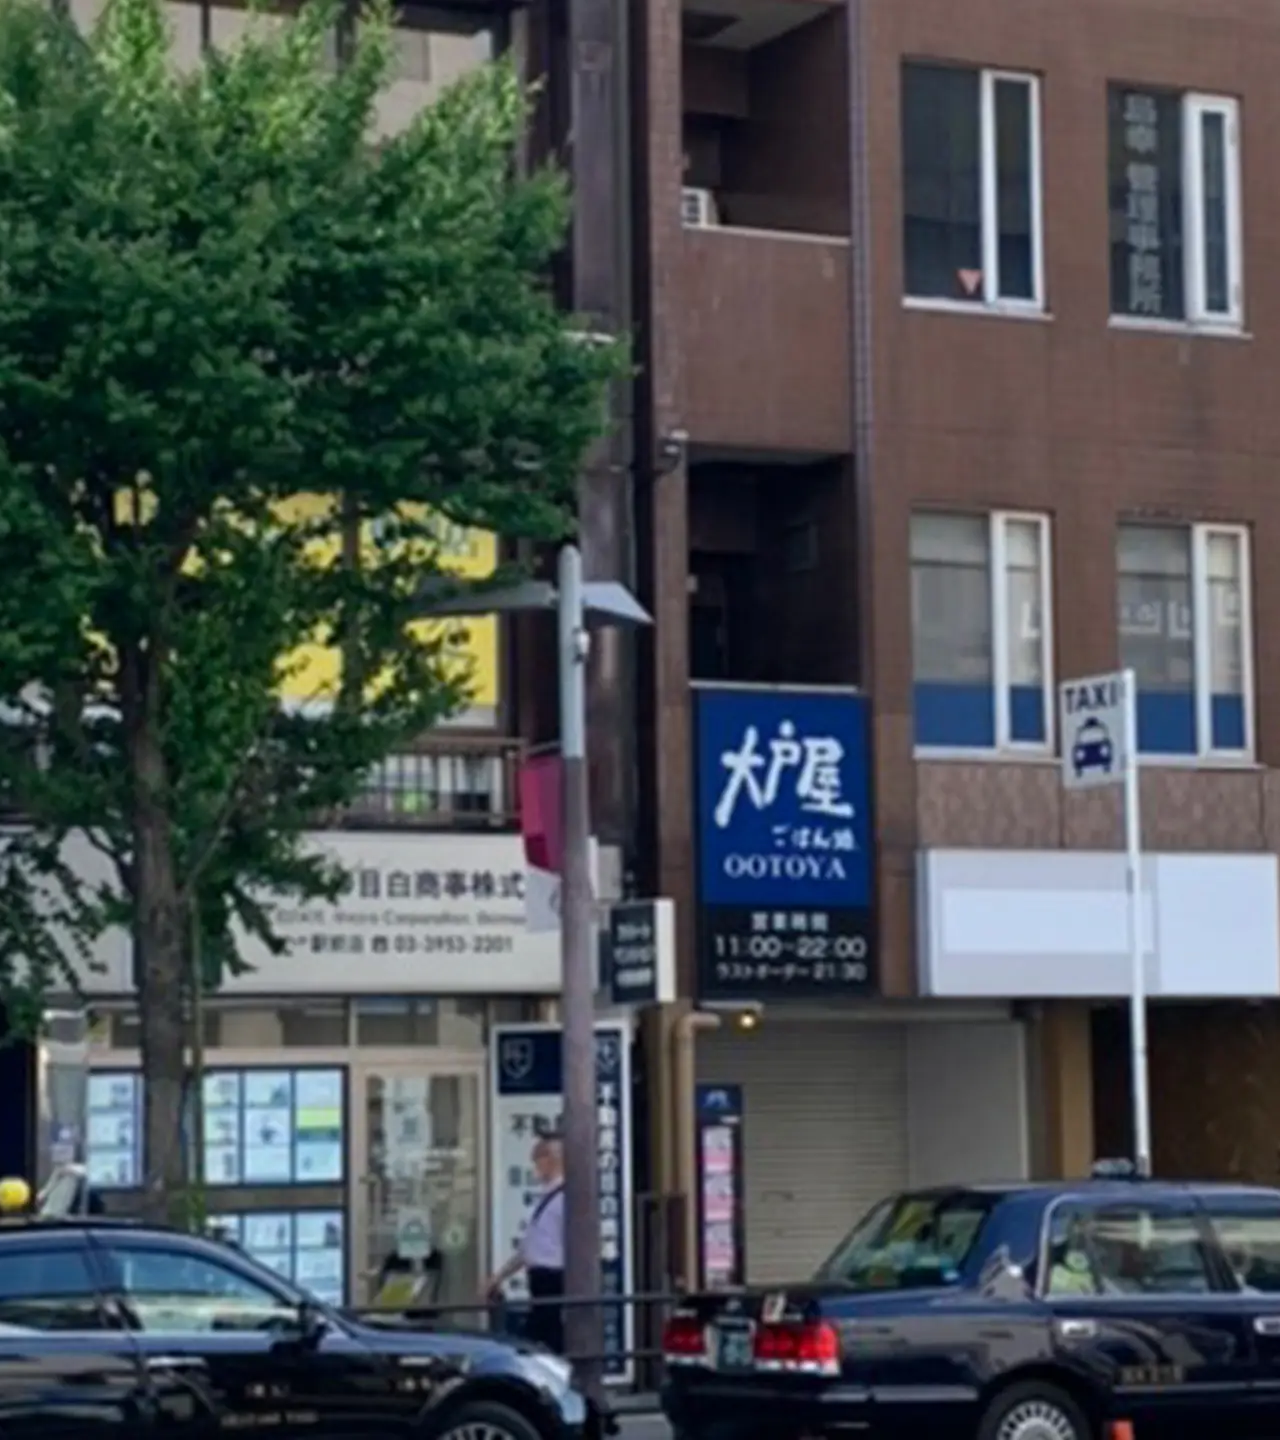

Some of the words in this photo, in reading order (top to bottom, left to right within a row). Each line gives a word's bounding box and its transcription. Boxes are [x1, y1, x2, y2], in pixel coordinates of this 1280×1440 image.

[1064, 679, 1124, 715] TAXI
[713, 719, 855, 827] 大戸屋
[723, 854, 848, 880] OOTOYA
